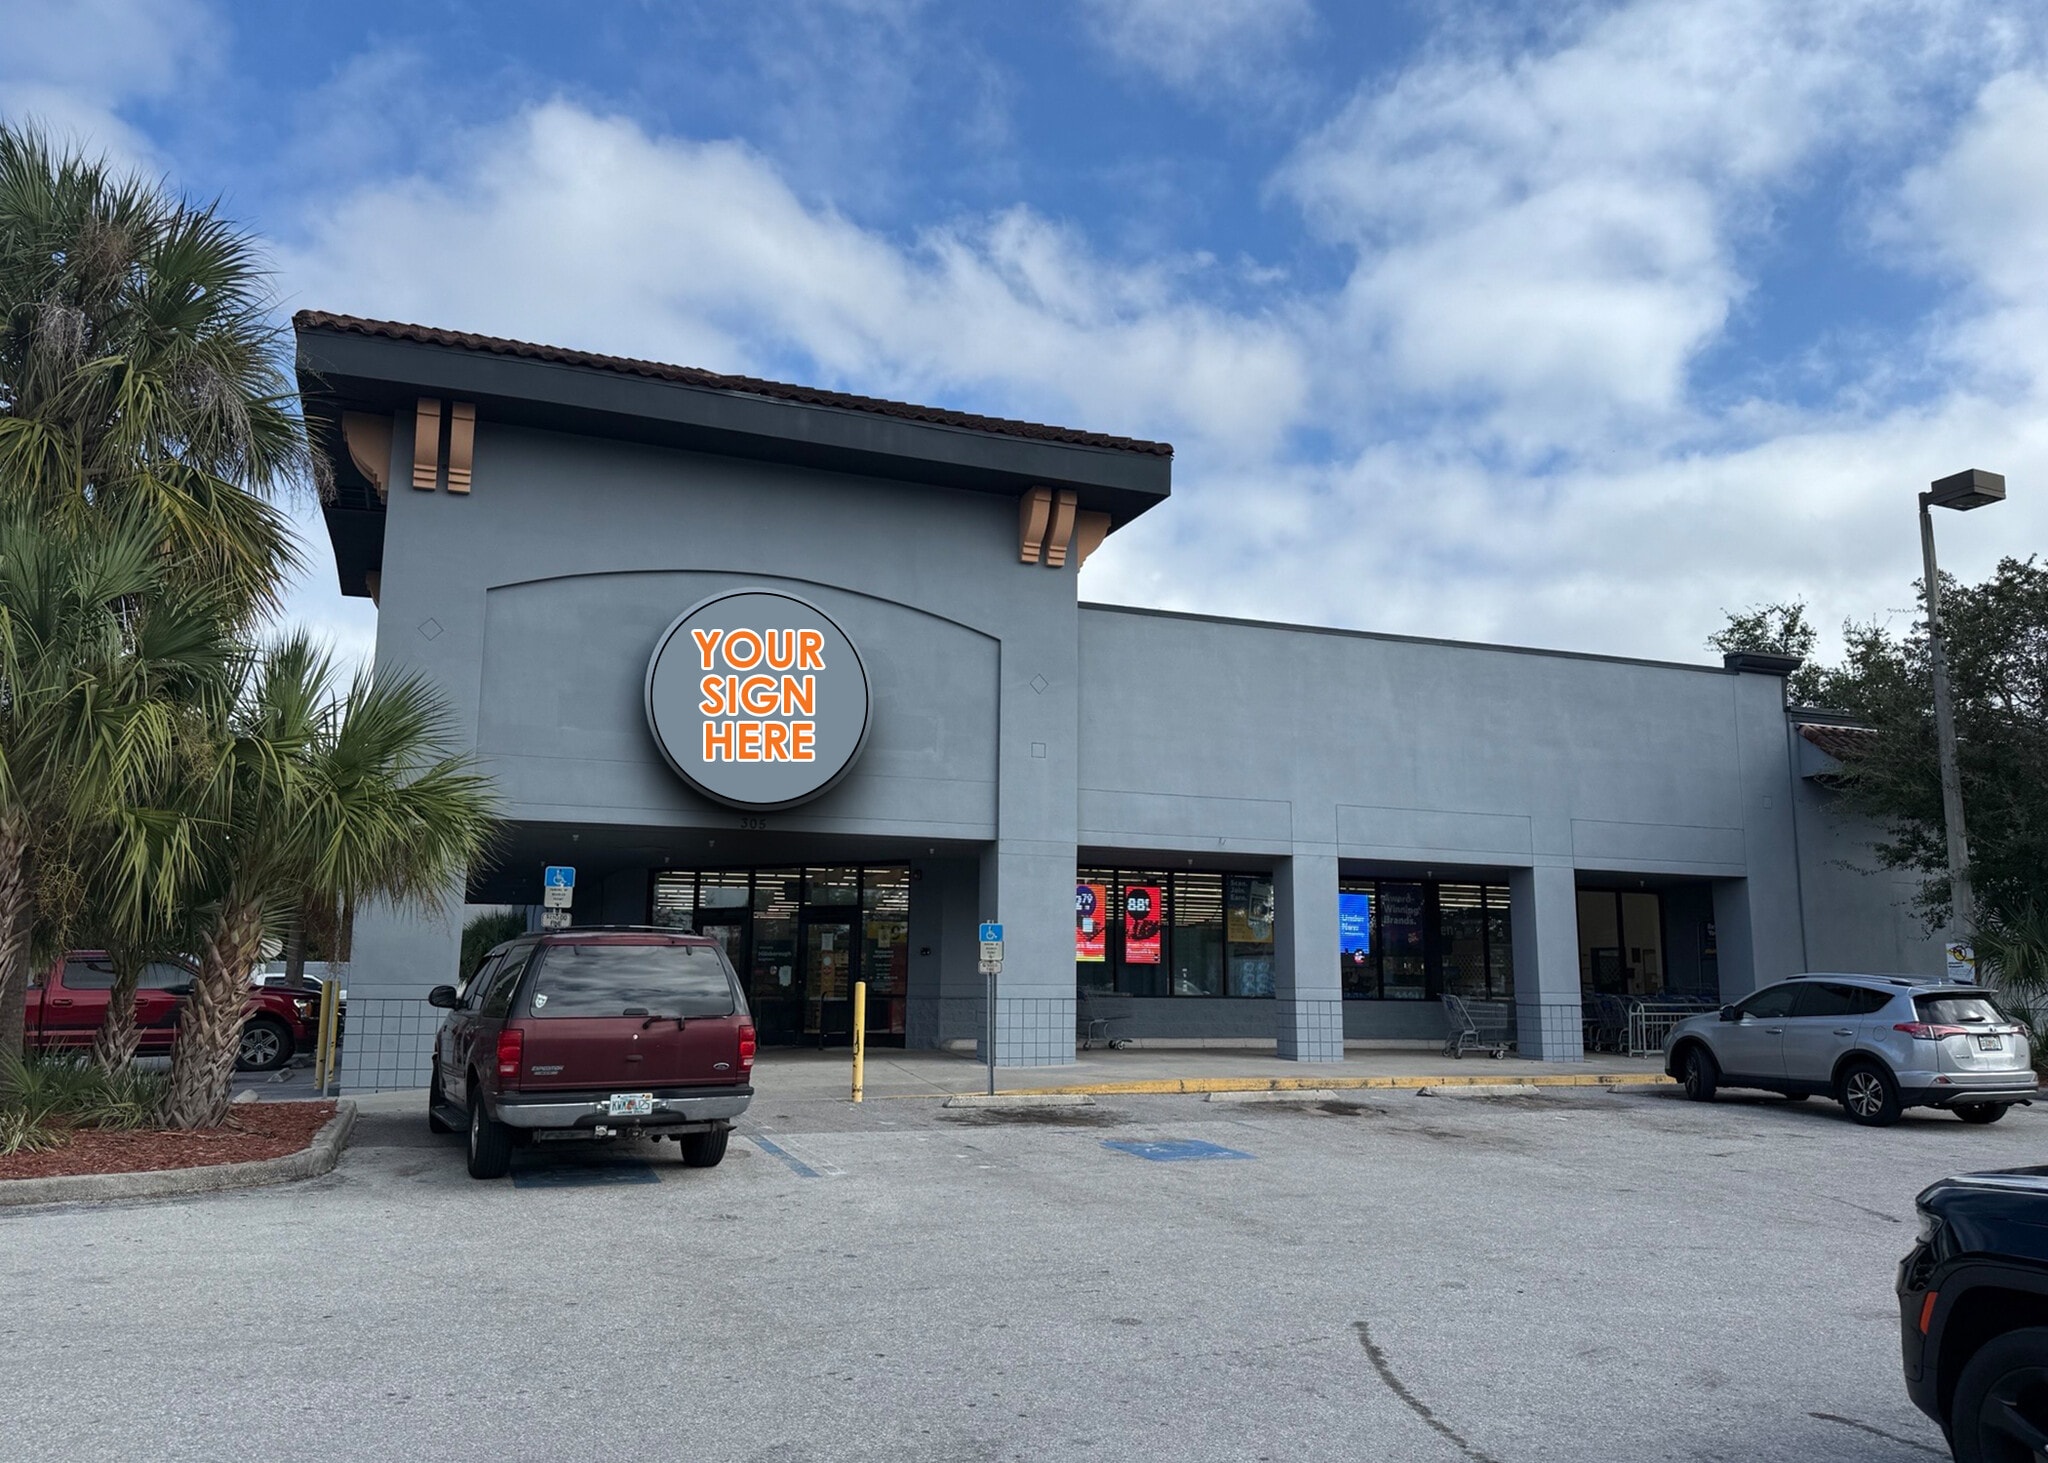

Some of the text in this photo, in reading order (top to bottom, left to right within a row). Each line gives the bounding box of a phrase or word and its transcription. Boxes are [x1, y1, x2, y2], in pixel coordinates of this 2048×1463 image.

[691, 628, 826, 670] YOUR
[699, 675, 816, 716] SIGN
[703, 721, 816, 762] HERE
[740, 817, 767, 829] 305
[1383, 904, 1420, 916] Winning
